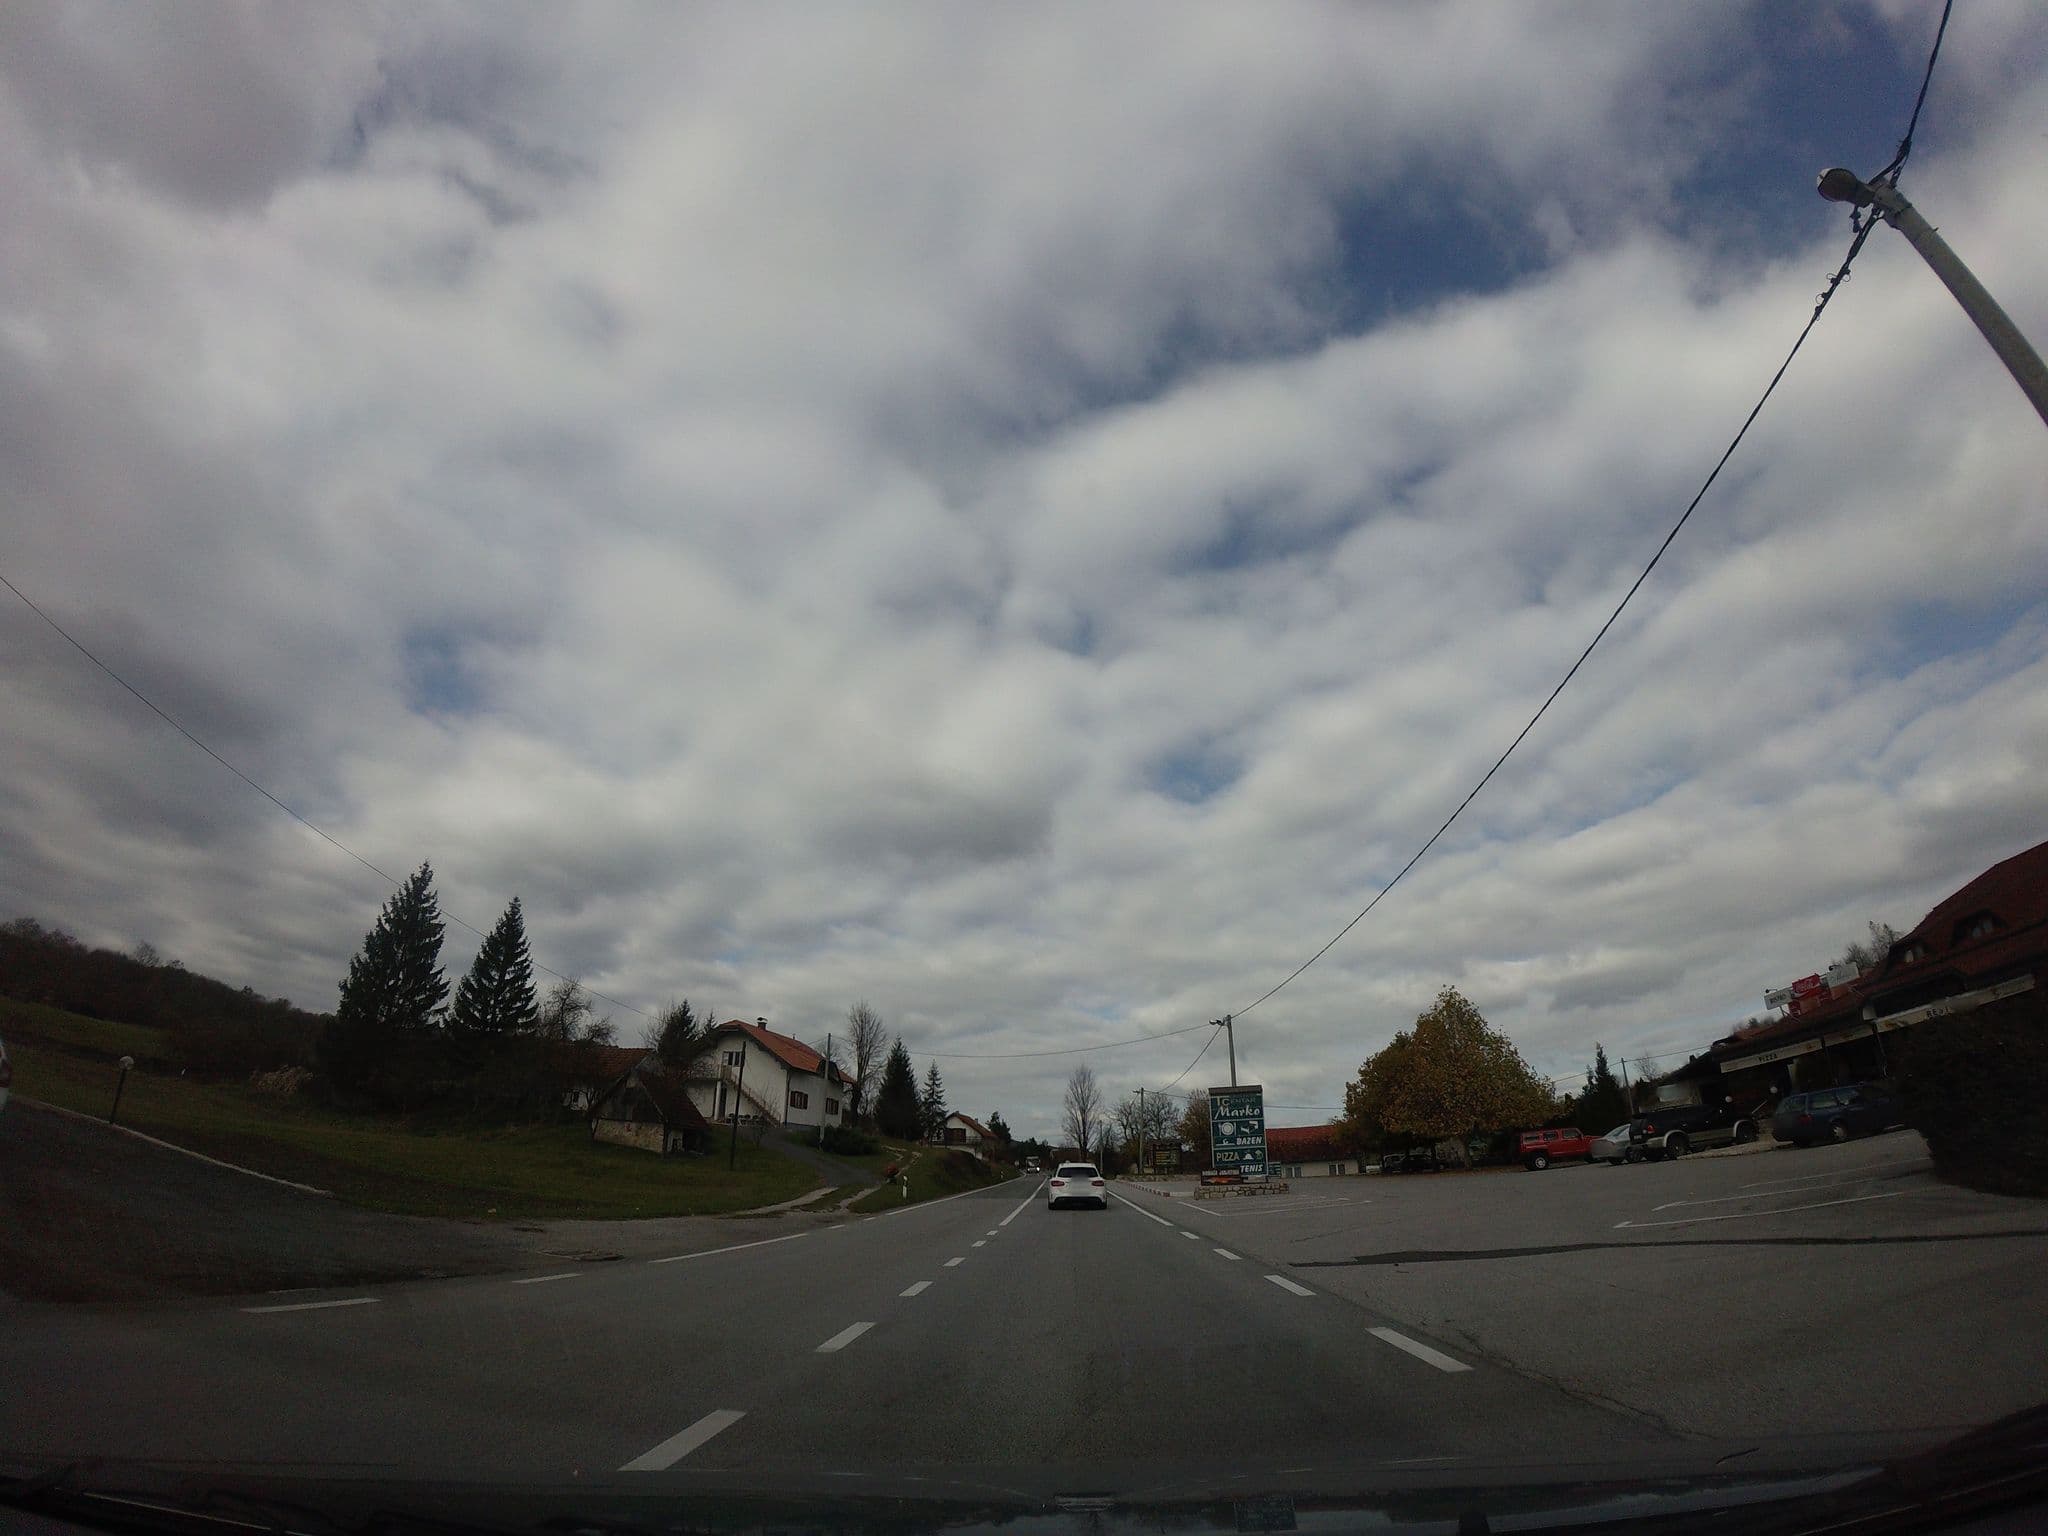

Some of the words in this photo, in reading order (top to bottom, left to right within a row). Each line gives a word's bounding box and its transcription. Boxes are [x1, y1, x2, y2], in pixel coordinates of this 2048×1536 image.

[1214, 1105, 1260, 1120] Marko
[1236, 1136, 1262, 1145] BAZEN
[1216, 1152, 1240, 1161] PIZZA
[1240, 1164, 1263, 1173] TENIS
